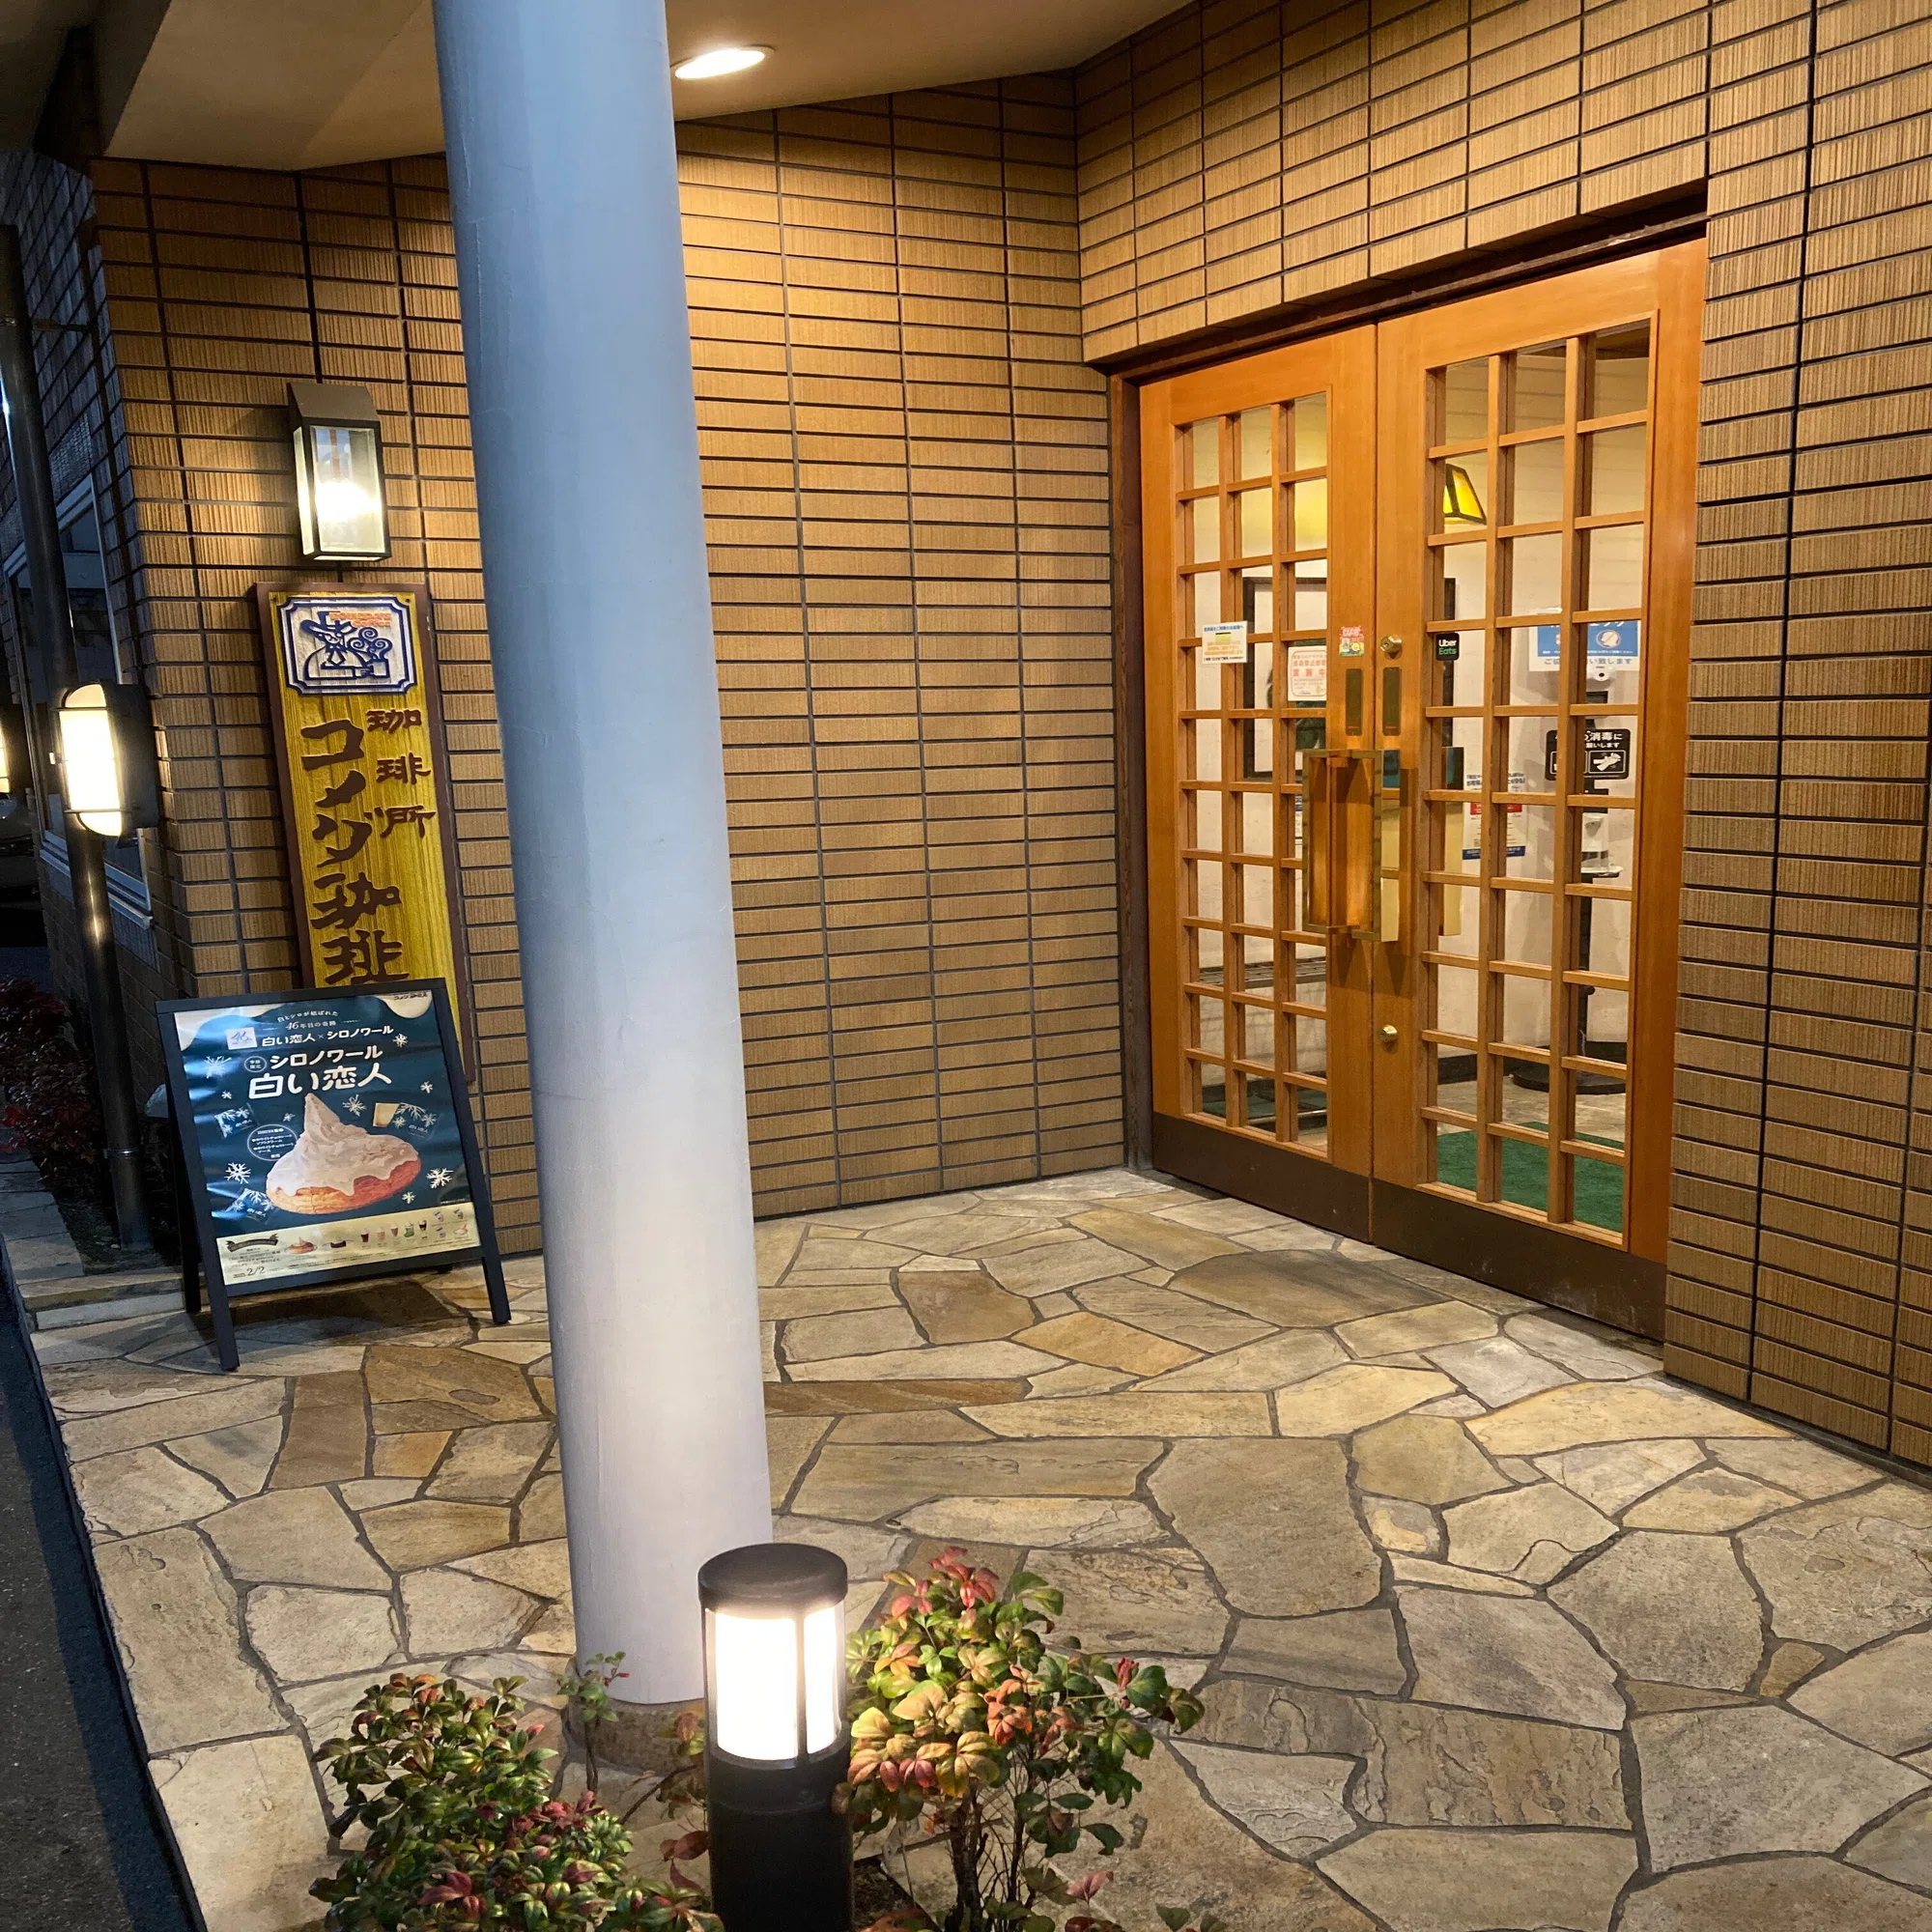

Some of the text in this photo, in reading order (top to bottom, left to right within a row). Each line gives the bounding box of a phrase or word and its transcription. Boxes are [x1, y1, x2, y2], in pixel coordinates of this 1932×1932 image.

[366, 709, 437, 838] 珈琲所
[300, 720, 410, 984] コメダ珈琲
[248, 1063, 391, 1099] 白い恋人
[270, 1045, 383, 1069] シロノワール
